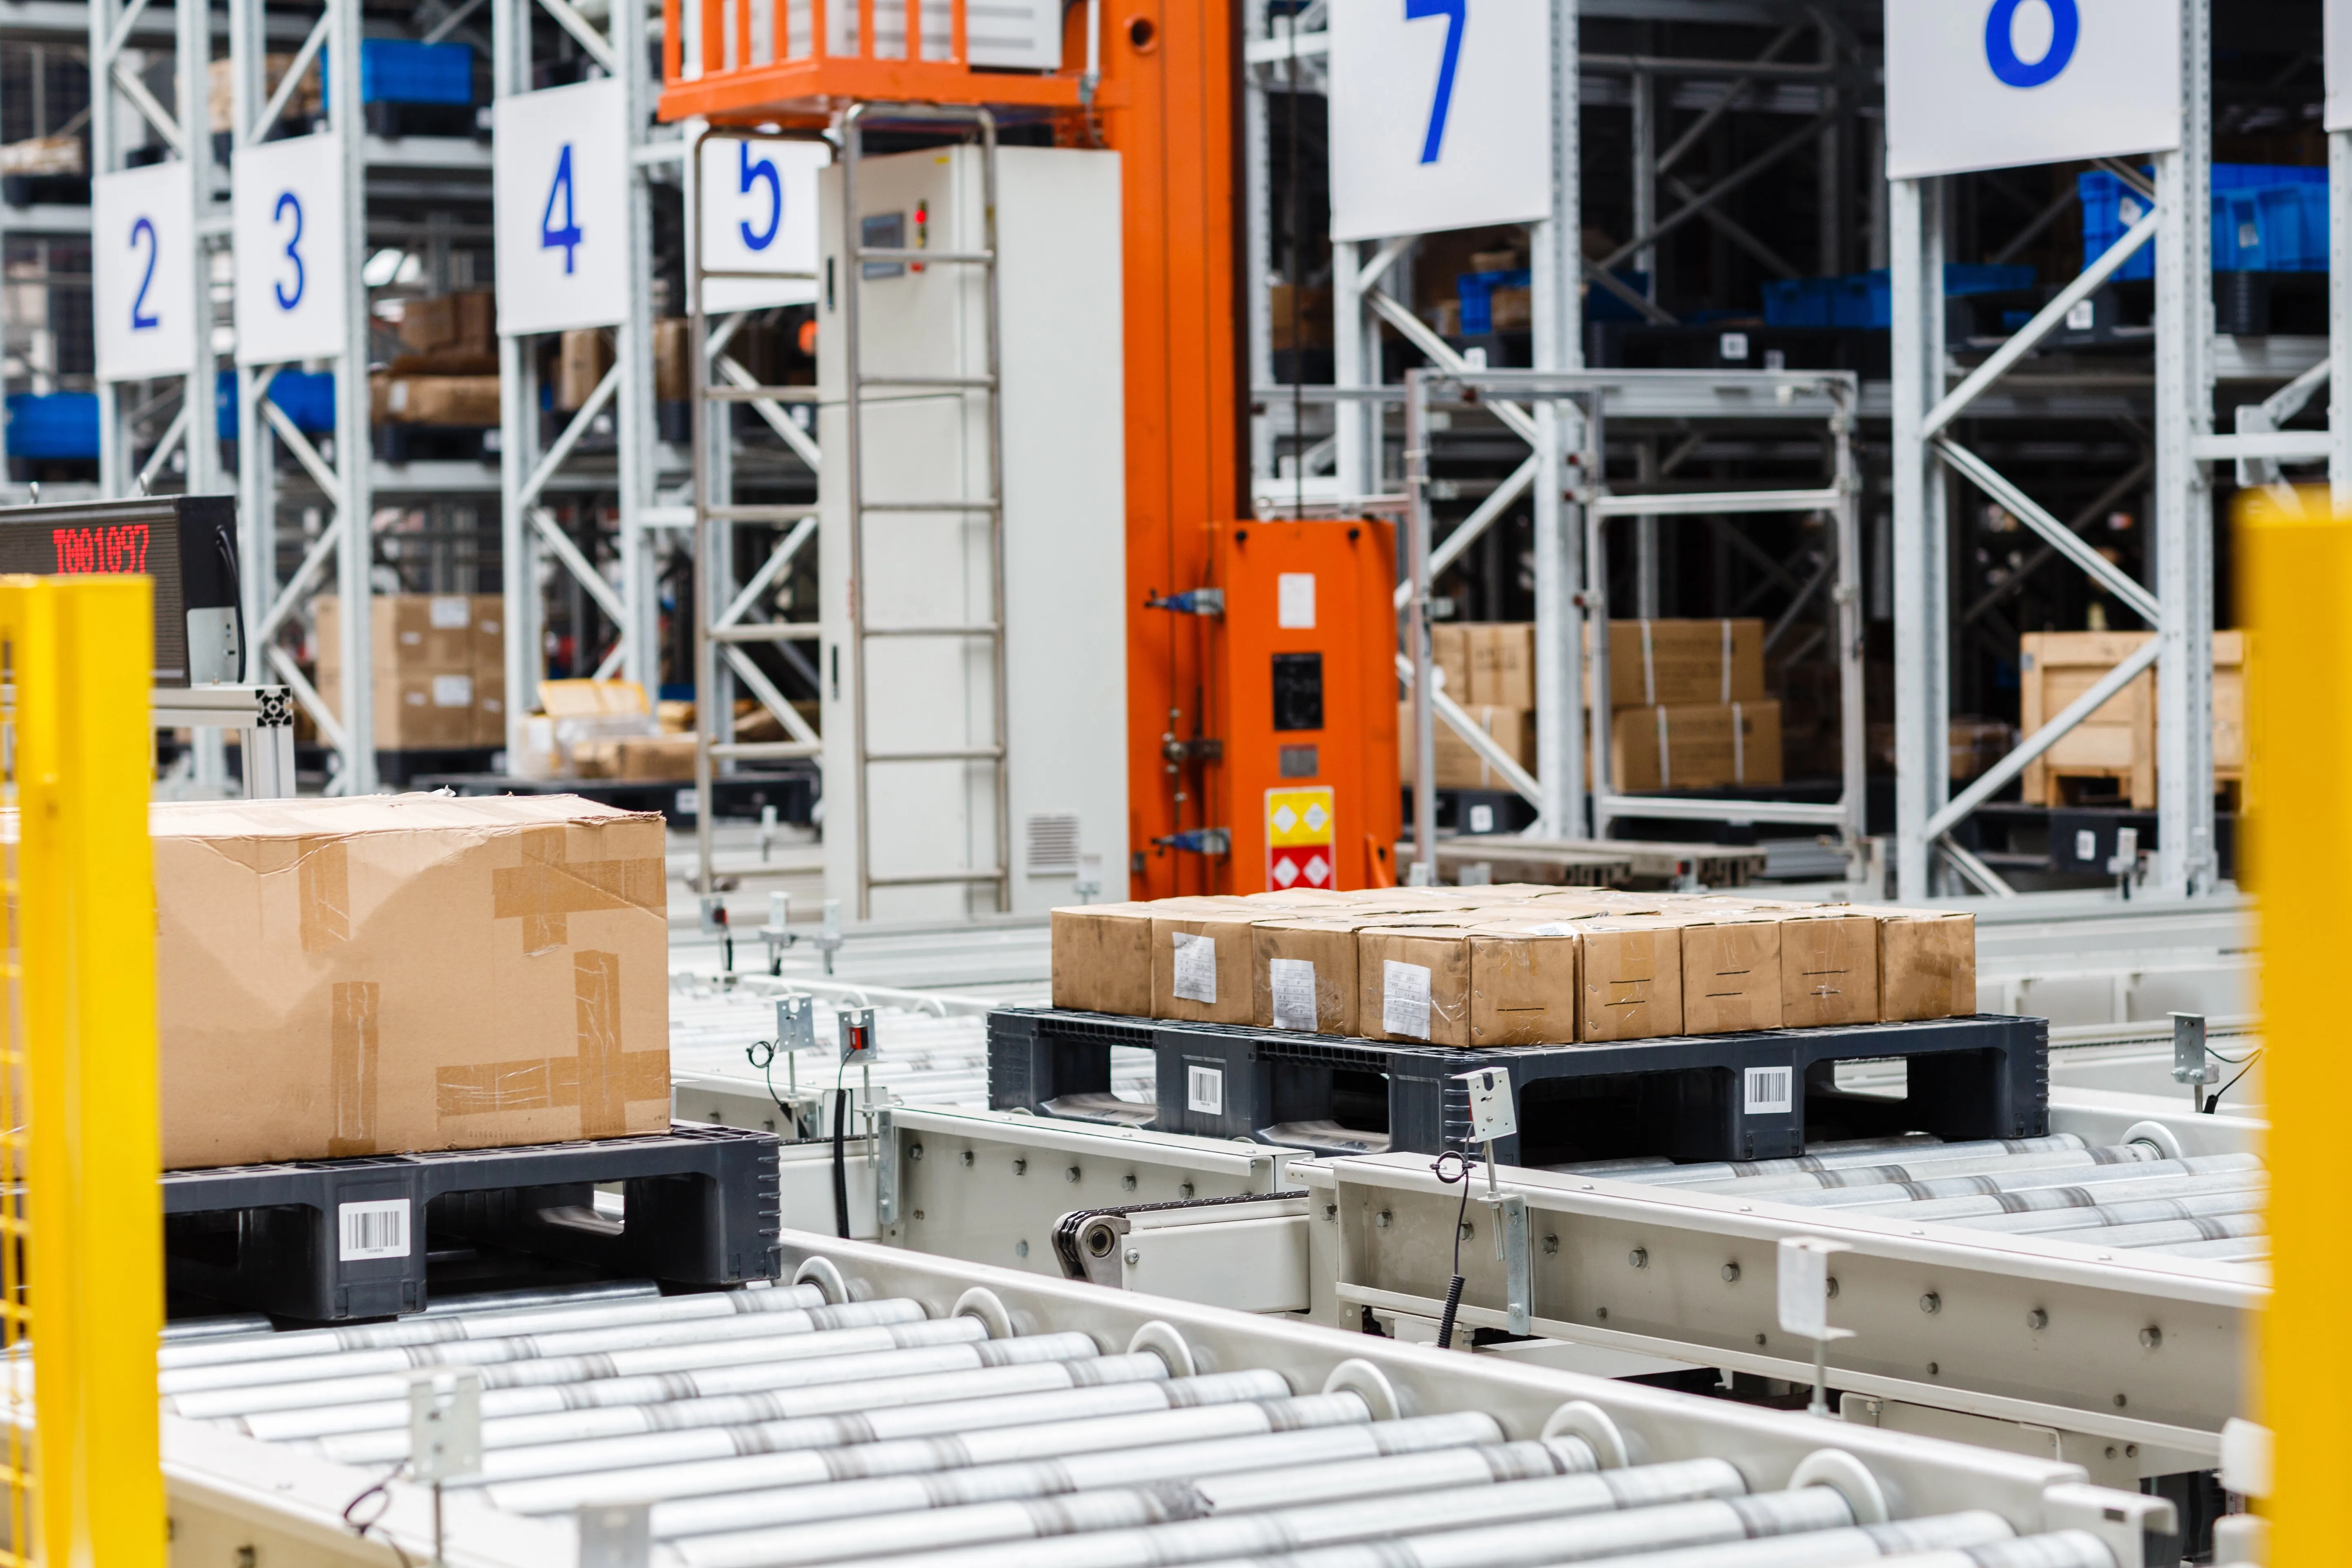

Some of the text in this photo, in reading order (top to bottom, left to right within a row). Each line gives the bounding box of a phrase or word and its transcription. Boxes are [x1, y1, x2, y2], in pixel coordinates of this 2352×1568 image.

[1405, 0, 1467, 165] 7
[274, 191, 304, 311] 3
[540, 144, 582, 275] 4
[739, 140, 782, 252] 5
[131, 217, 158, 330] 2
